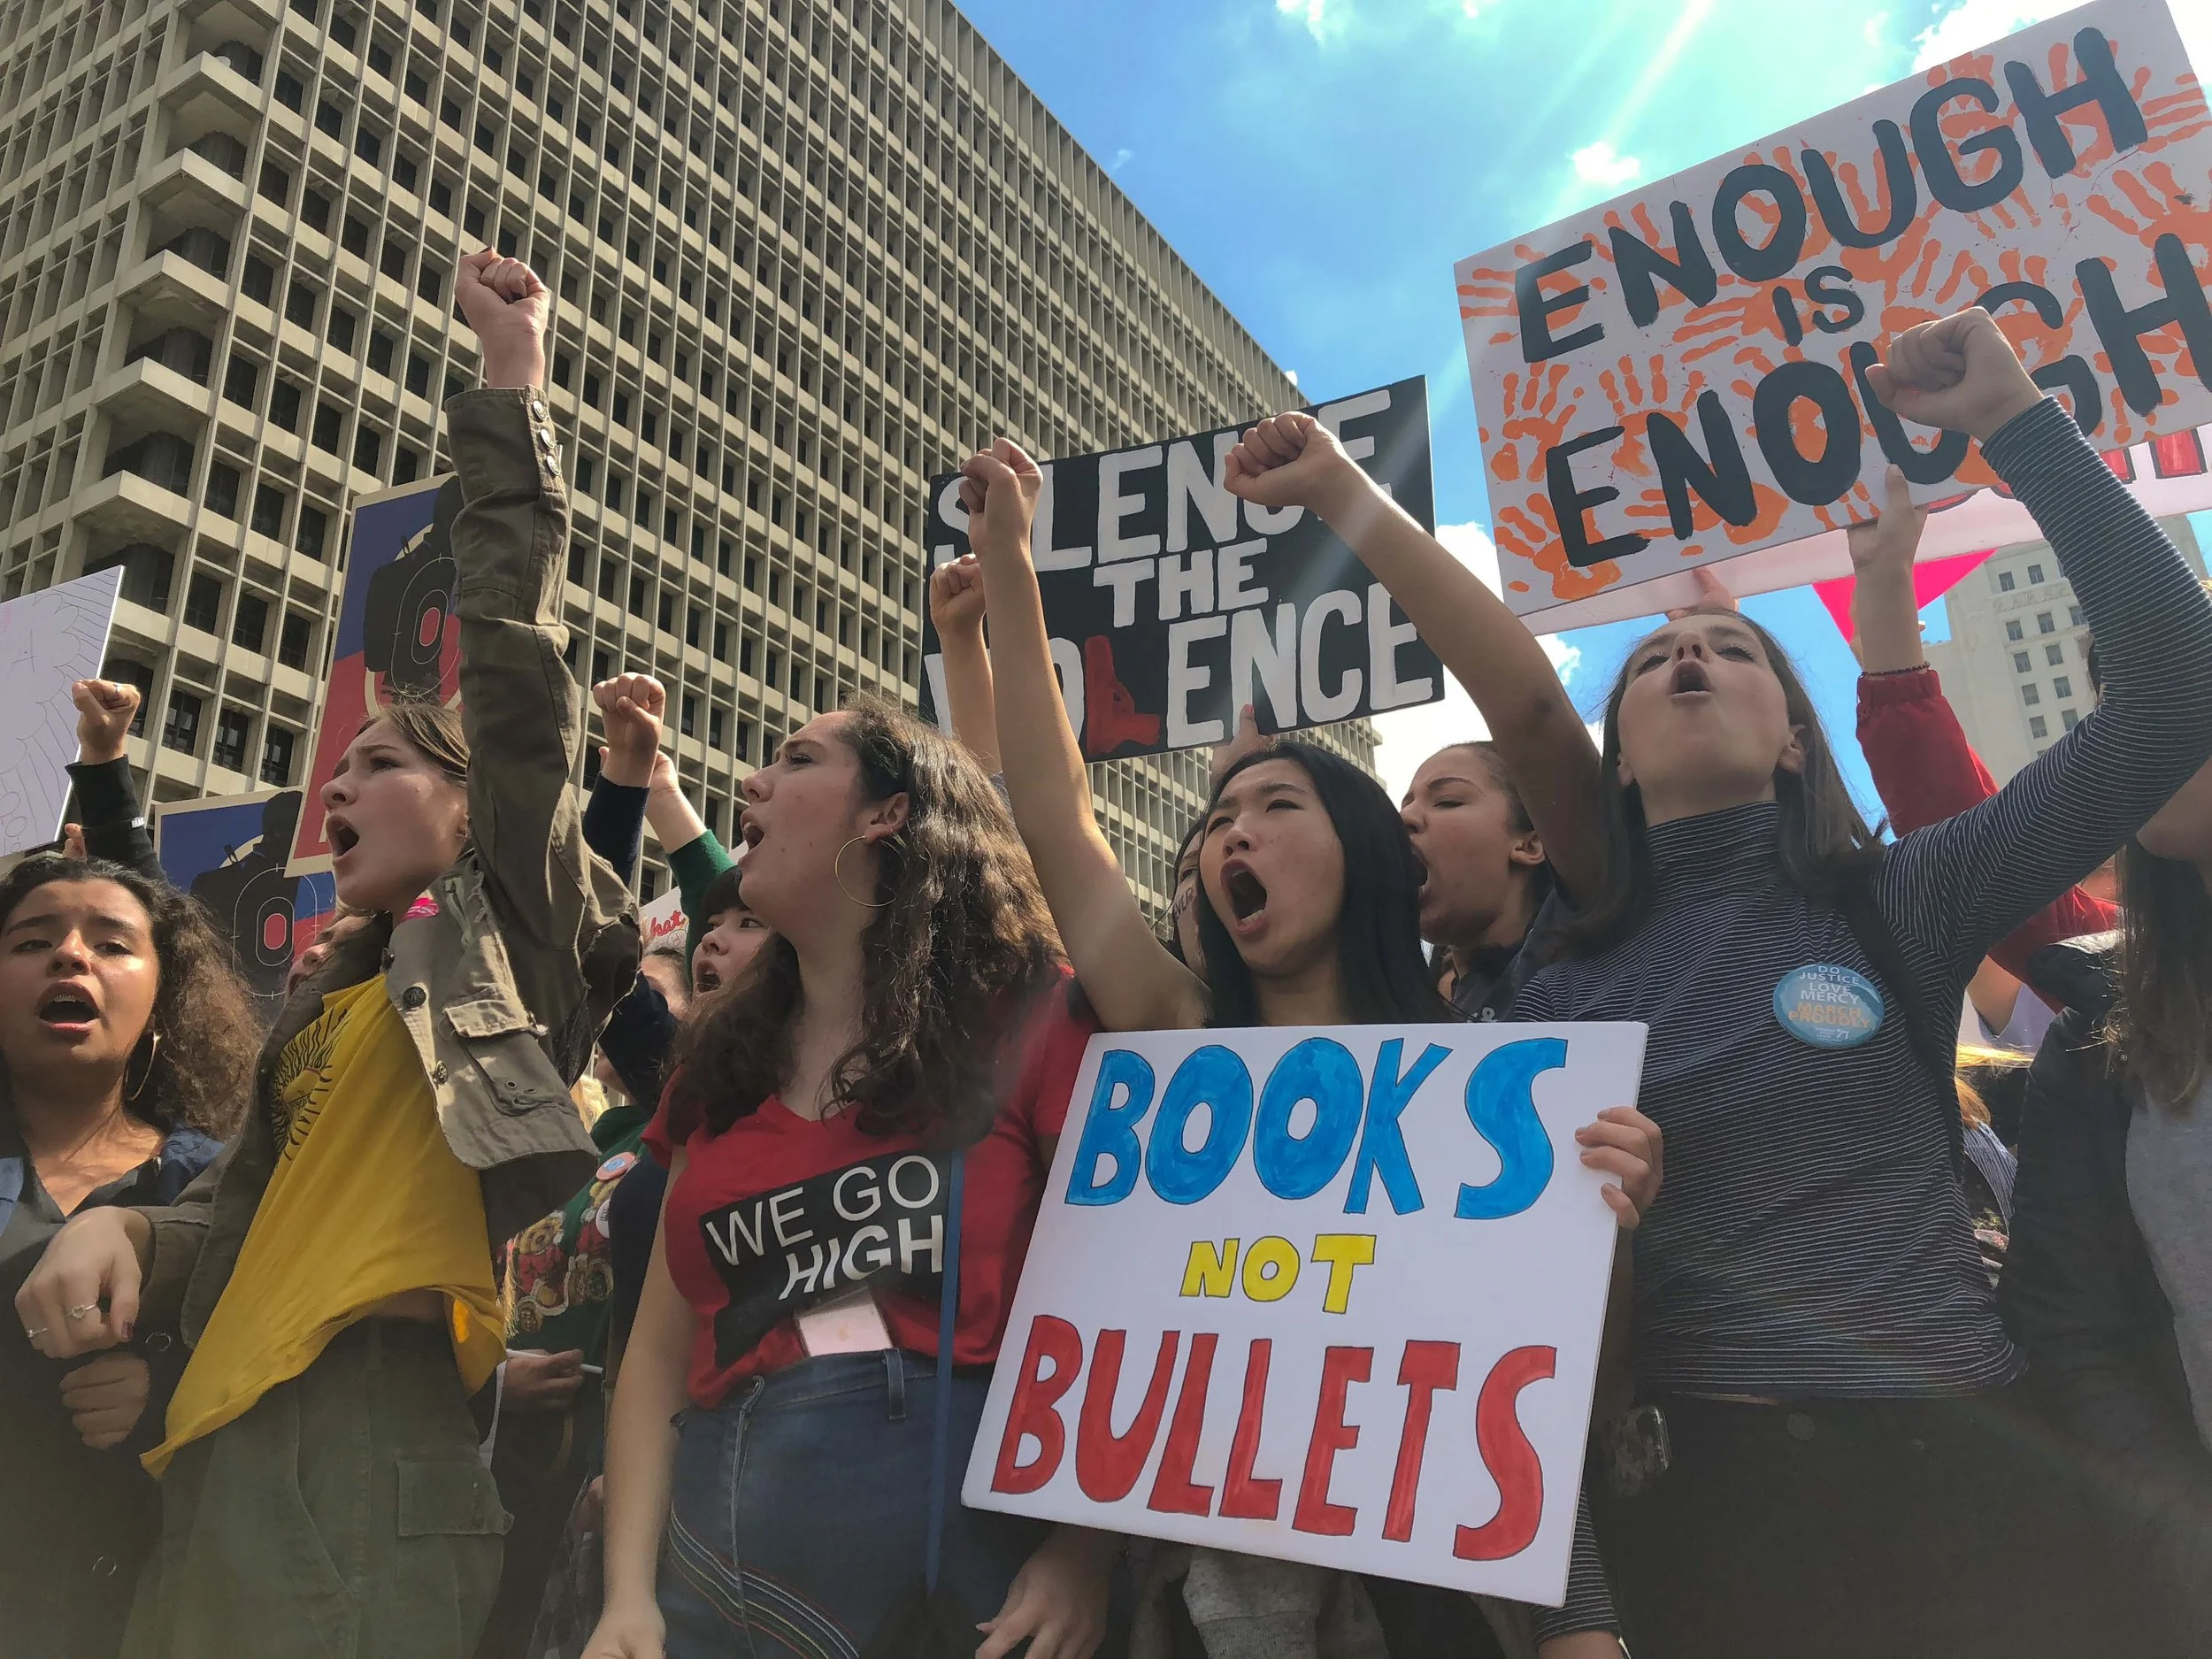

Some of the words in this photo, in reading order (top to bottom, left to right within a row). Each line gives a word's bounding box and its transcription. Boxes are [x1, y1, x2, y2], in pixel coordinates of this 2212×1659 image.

[1515, 27, 2149, 364] ENOUGH
[1772, 265, 1865, 347] IS
[1093, 537, 1269, 628] THE
[1797, 1002, 1863, 1018] MARCH
[1799, 972, 1860, 985] JUSTICE
[1801, 989, 1859, 1005] MERCY
[1809, 982, 1851, 995] LOVE
[1817, 965, 1840, 974] DO
[1788, 1010, 1870, 1028] PROUDLY
[1064, 1036, 1569, 1220] BOOKS
[705, 1187, 814, 1266] WE
[833, 1155, 940, 1221] GO
[778, 1214, 944, 1301] HIGH
[1179, 1233, 1377, 1314] NOT
[990, 1315, 1557, 1562] BULLETS
